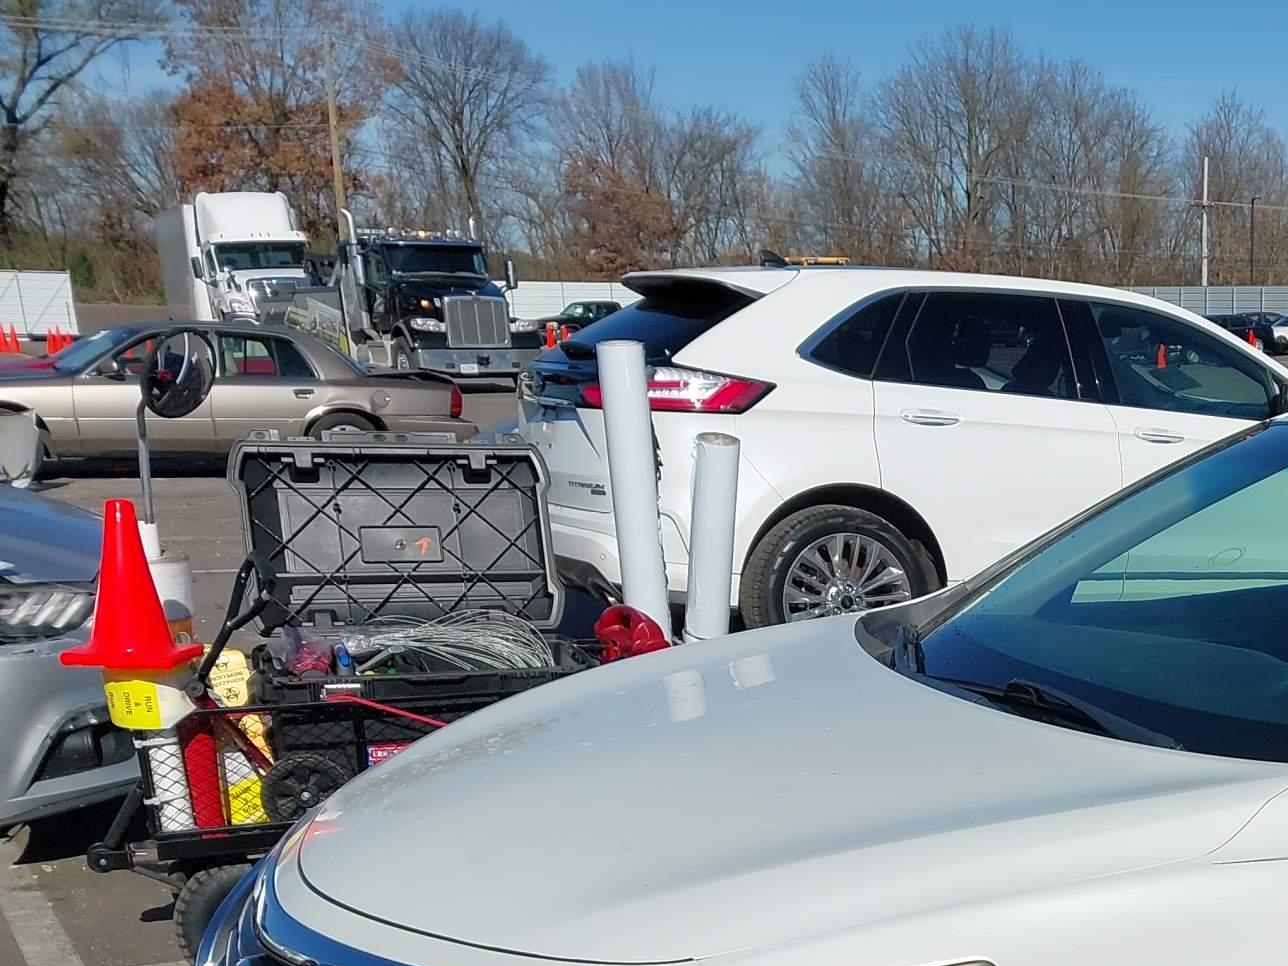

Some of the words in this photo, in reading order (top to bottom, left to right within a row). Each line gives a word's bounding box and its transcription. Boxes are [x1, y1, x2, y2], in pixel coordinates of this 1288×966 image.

[568, 480, 605, 488] TITANIUM
[123, 692, 133, 715] DRIVE
[144, 695, 153, 713] RUN
